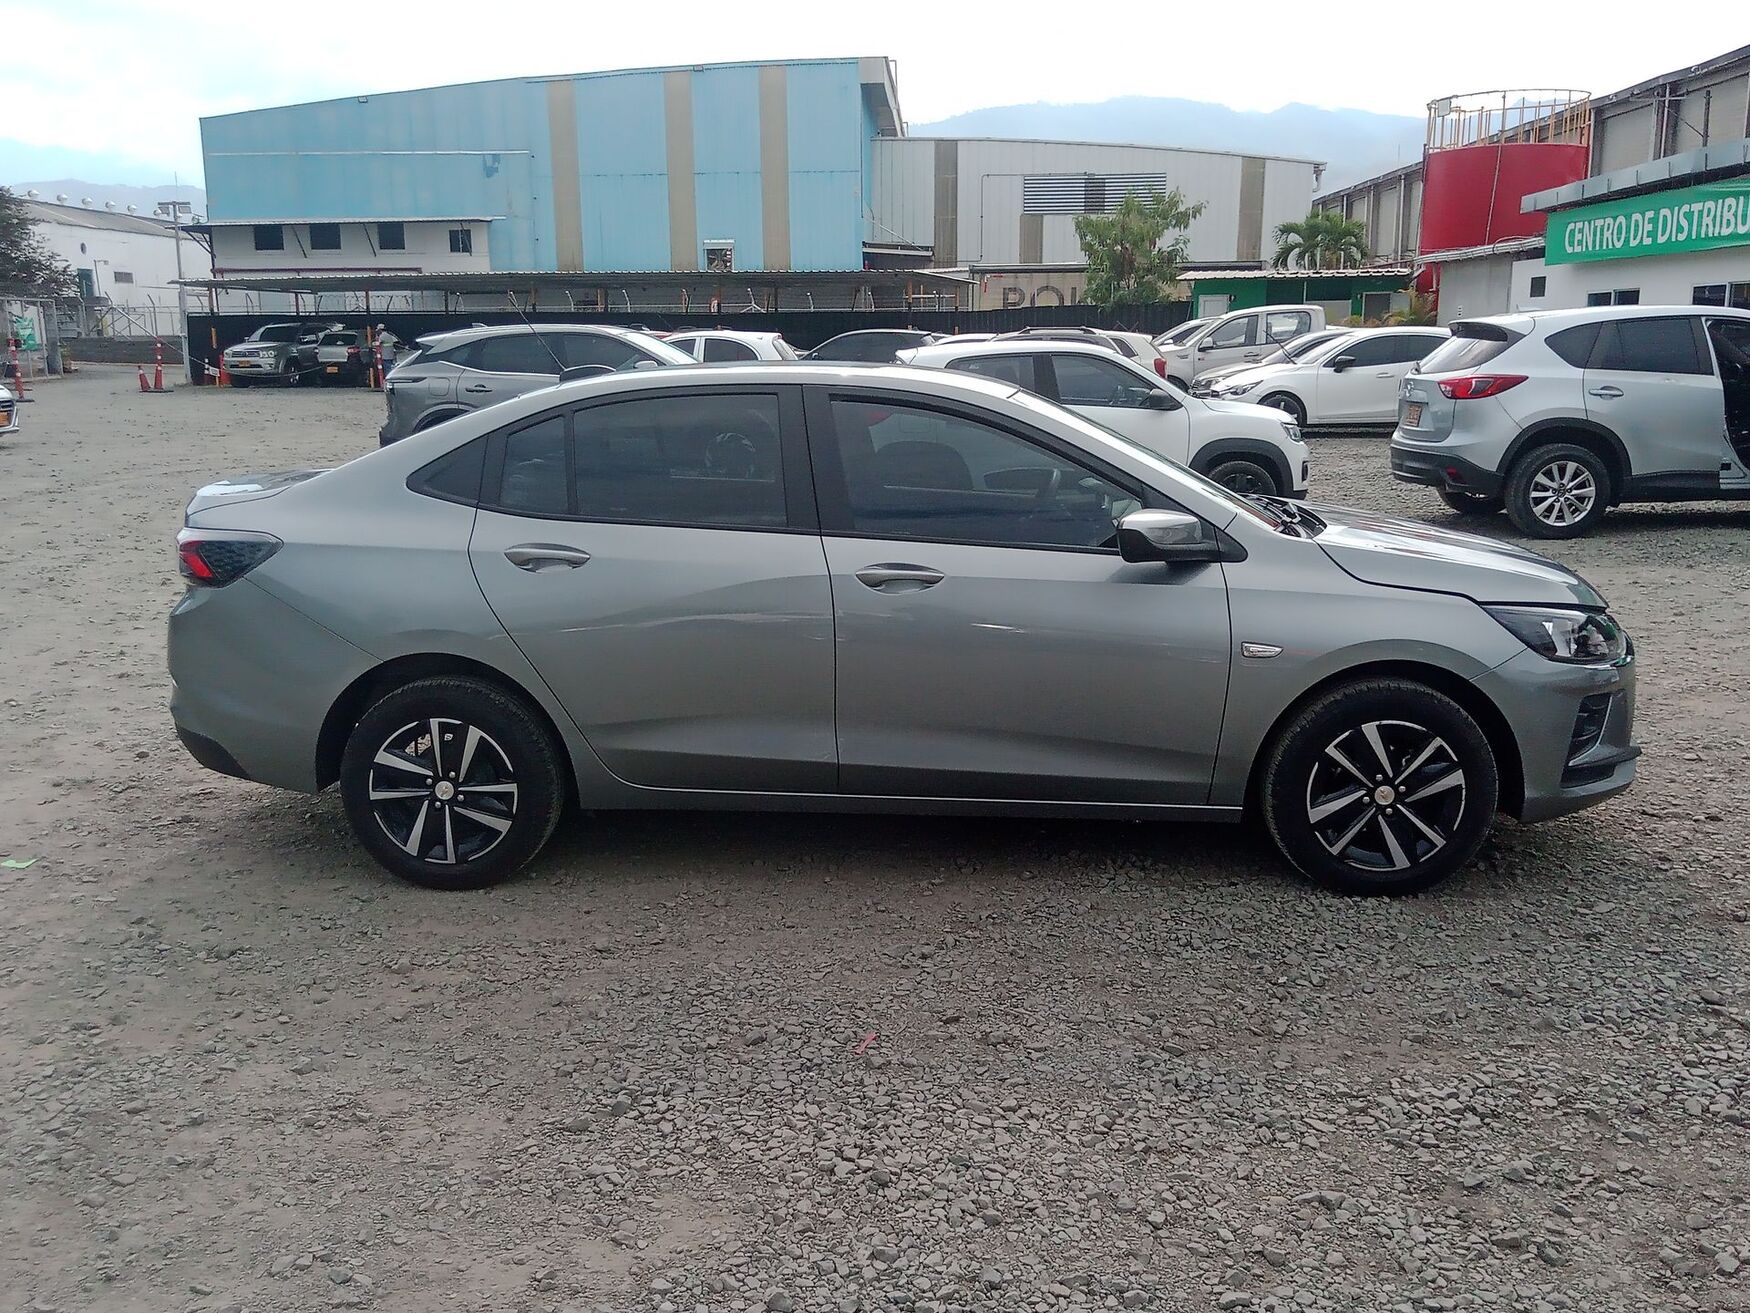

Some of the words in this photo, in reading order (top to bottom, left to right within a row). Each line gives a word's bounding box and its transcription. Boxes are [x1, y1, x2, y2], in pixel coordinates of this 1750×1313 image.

[1565, 215, 1626, 253] CENTRO
[1630, 210, 1655, 247] DE
[1657, 195, 1750, 244] DISTRIBU
